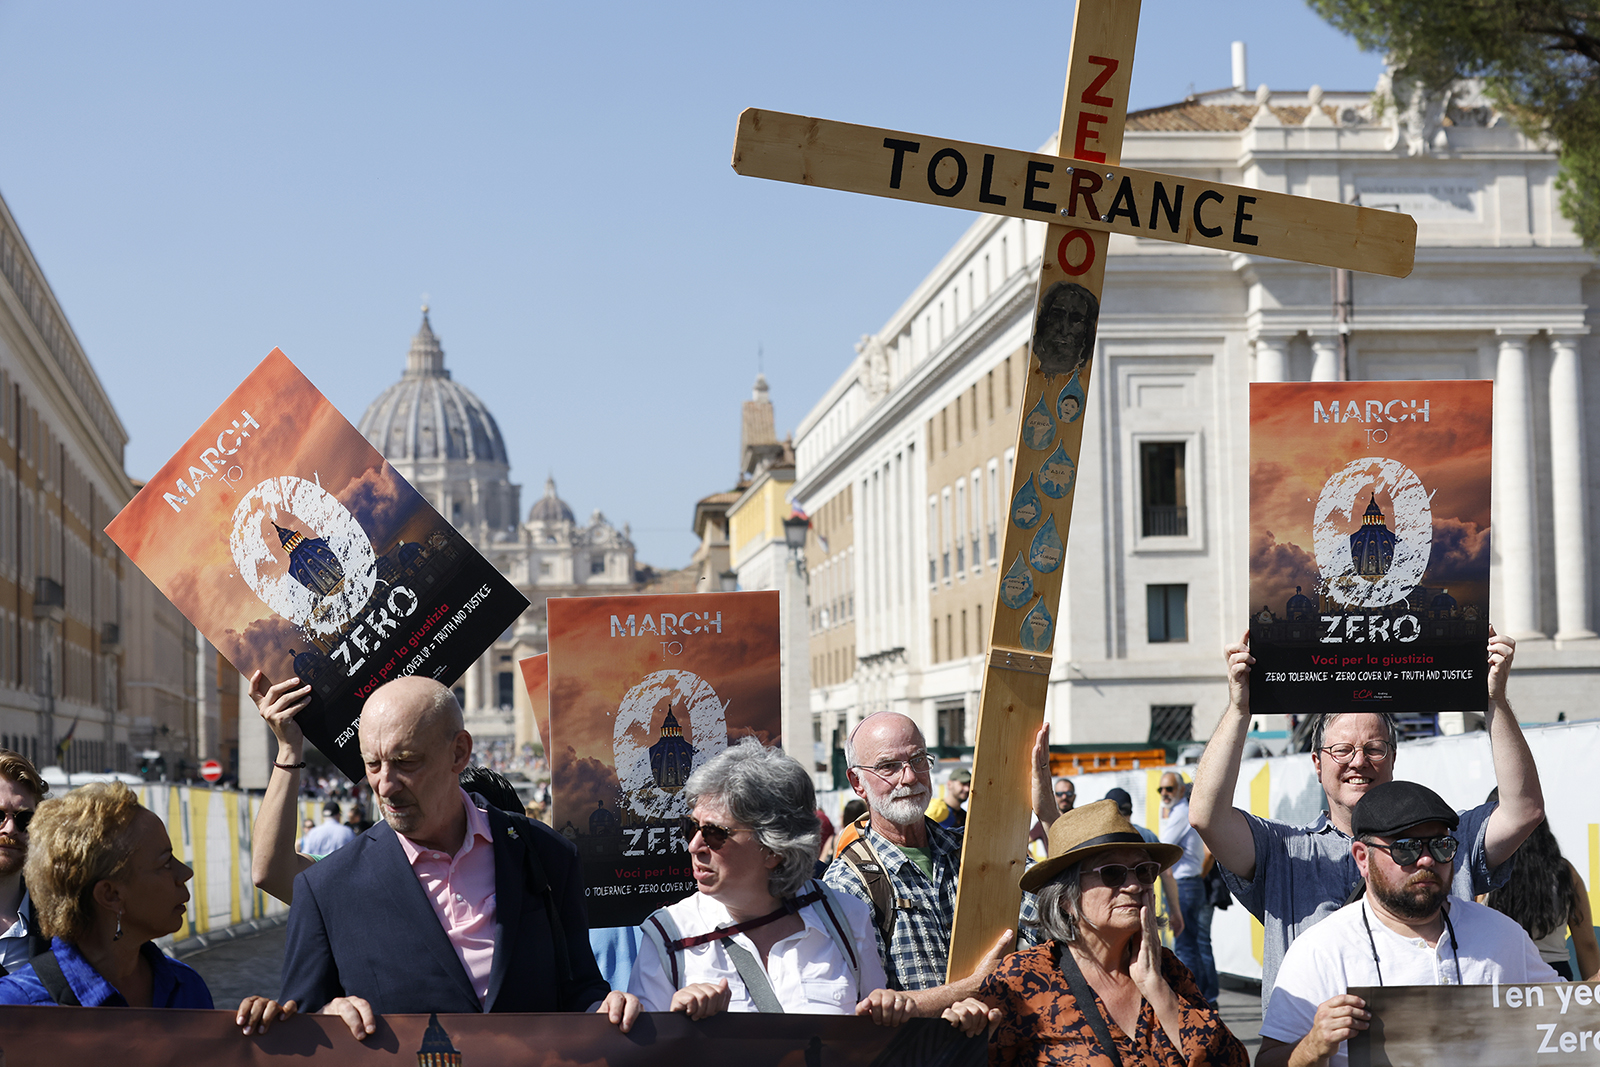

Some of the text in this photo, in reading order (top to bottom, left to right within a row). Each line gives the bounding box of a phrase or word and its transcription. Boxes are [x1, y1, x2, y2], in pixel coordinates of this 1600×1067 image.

[1057, 55, 1119, 276] ZERO
[883, 137, 1259, 246] TOLERANCE
[1313, 399, 1430, 423] MARCH
[1364, 428, 1388, 448] TO
[163, 409, 260, 513] MARCH
[219, 465, 243, 493] TO
[330, 585, 419, 678] ZERO
[610, 611, 722, 637] MARCH
[1319, 614, 1421, 643] ZERO
[354, 603, 450, 699] Voci per la giustizia
[660, 641, 683, 661] TO
[1311, 653, 1434, 667] Voci per la giustizia
[334, 727, 355, 748] ZERO
[402, 654, 425, 677] COVER
[420, 646, 432, 658] UP
[433, 621, 458, 645] TRUTH
[452, 609, 467, 626] AND
[463, 583, 492, 614] JUSTICE
[1265, 672, 1287, 682] ZERO
[1288, 671, 1329, 682] TOLERANCE
[1335, 671, 1357, 681] ZERO
[1358, 671, 1382, 681] COVER
[1383, 670, 1393, 681] UP
[1400, 670, 1425, 681] TRUTH
[1426, 670, 1440, 680] AND
[1442, 669, 1474, 680] JUSTICE
[1353, 689, 1373, 699] ECA
[622, 826, 690, 857] ZER
[615, 867, 640, 878] Voci
[644, 868, 665, 879] per
[669, 865, 679, 876] la
[592, 884, 632, 897] TOLERANCE
[639, 883, 659, 894] ZERO
[660, 881, 684, 893] COVER
[685, 881, 694, 891] UP
